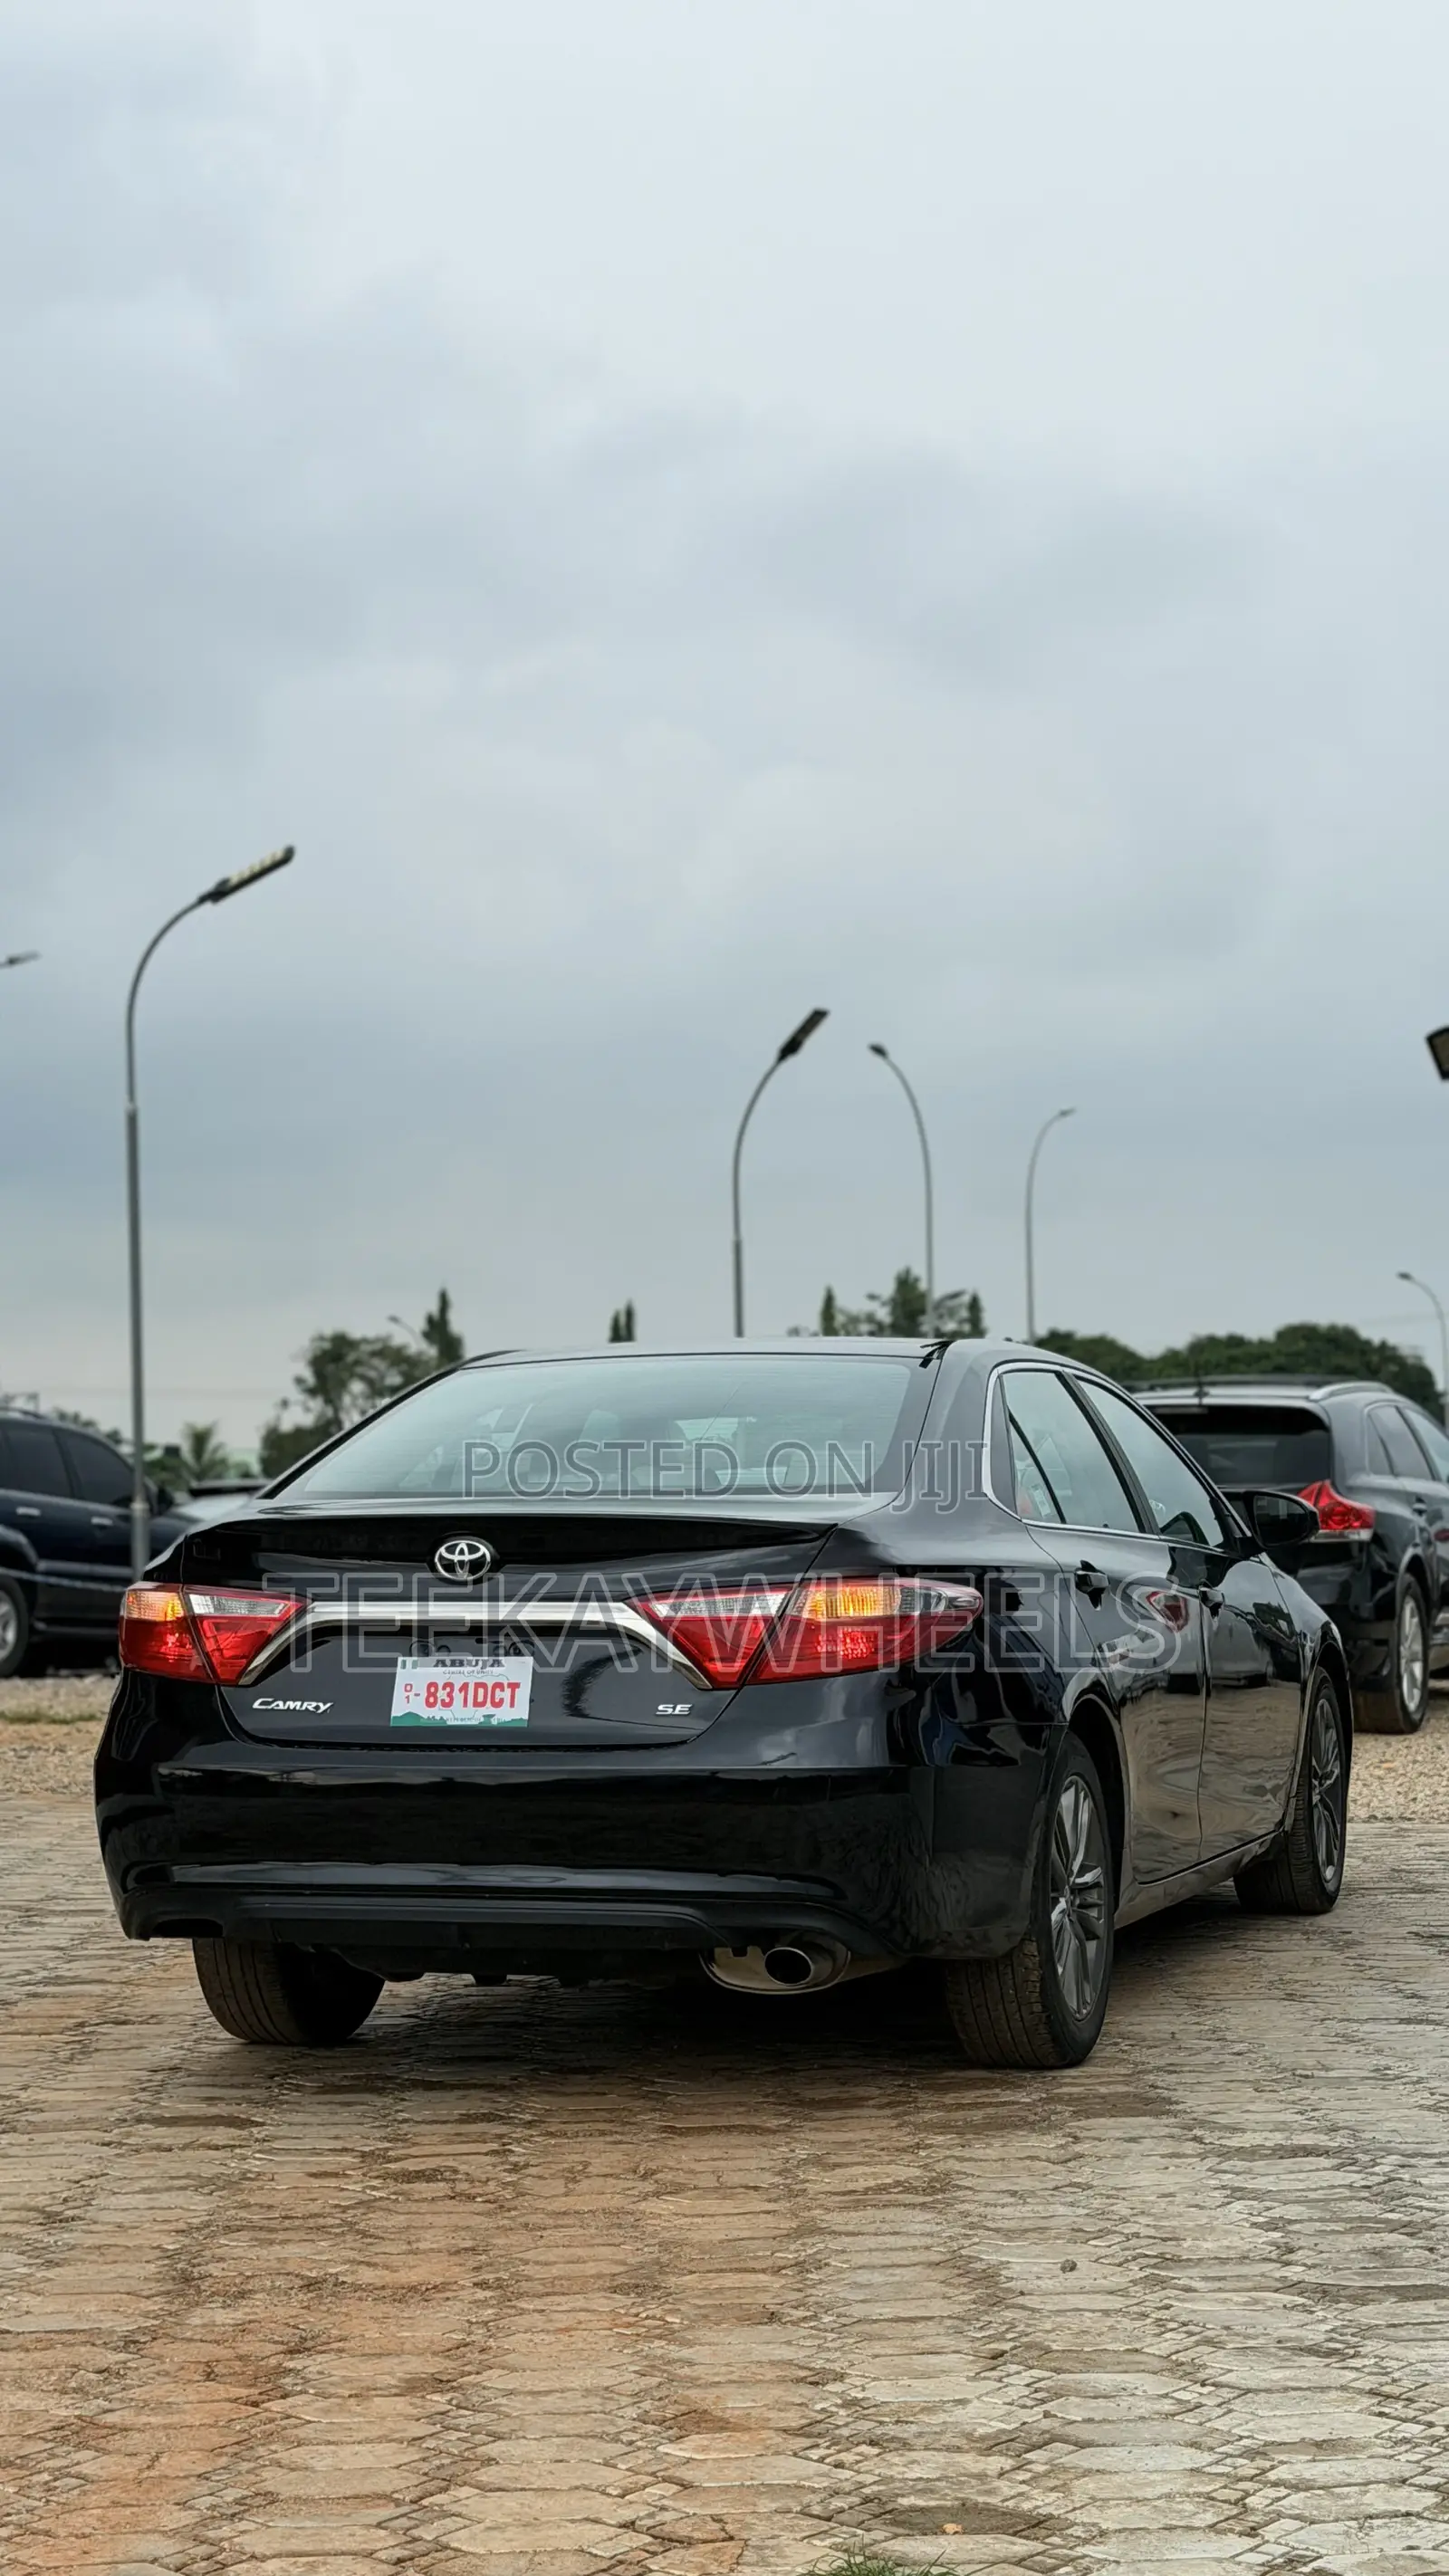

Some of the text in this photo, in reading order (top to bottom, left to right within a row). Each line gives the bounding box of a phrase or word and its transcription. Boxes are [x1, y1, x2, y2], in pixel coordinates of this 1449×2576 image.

[433, 1658, 505, 1670] ABUJA
[252, 1698, 334, 1714] CAMRY
[655, 1703, 693, 1715] SE
